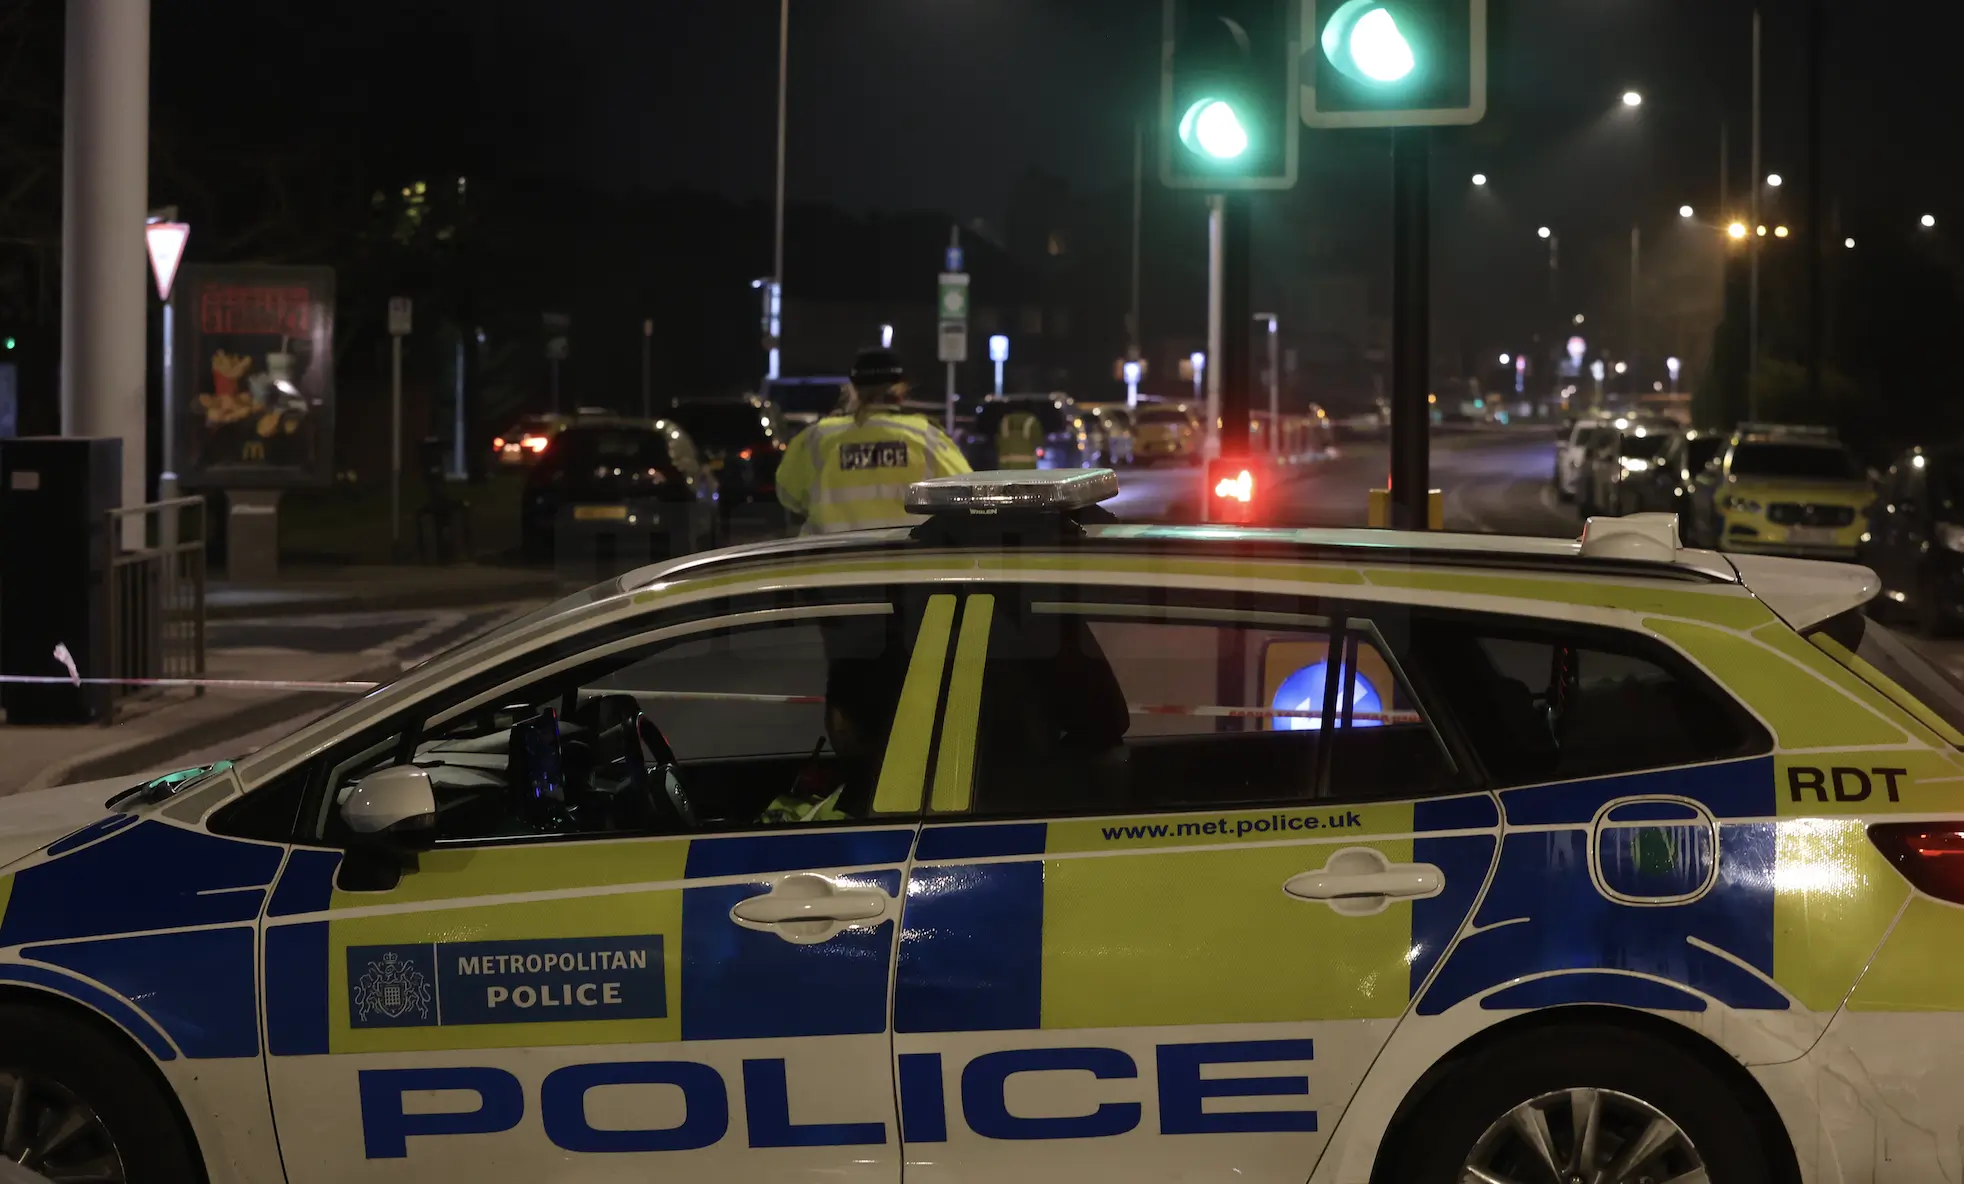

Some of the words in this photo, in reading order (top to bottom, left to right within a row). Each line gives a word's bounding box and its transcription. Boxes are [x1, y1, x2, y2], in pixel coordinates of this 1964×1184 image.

[1787, 766, 1908, 803] RDT
[1101, 811, 1361, 841] www.met.police.uk
[457, 949, 647, 976] METROPOLITAN
[486, 981, 623, 1009] POLICE
[357, 1038, 1320, 1161] POLICE
